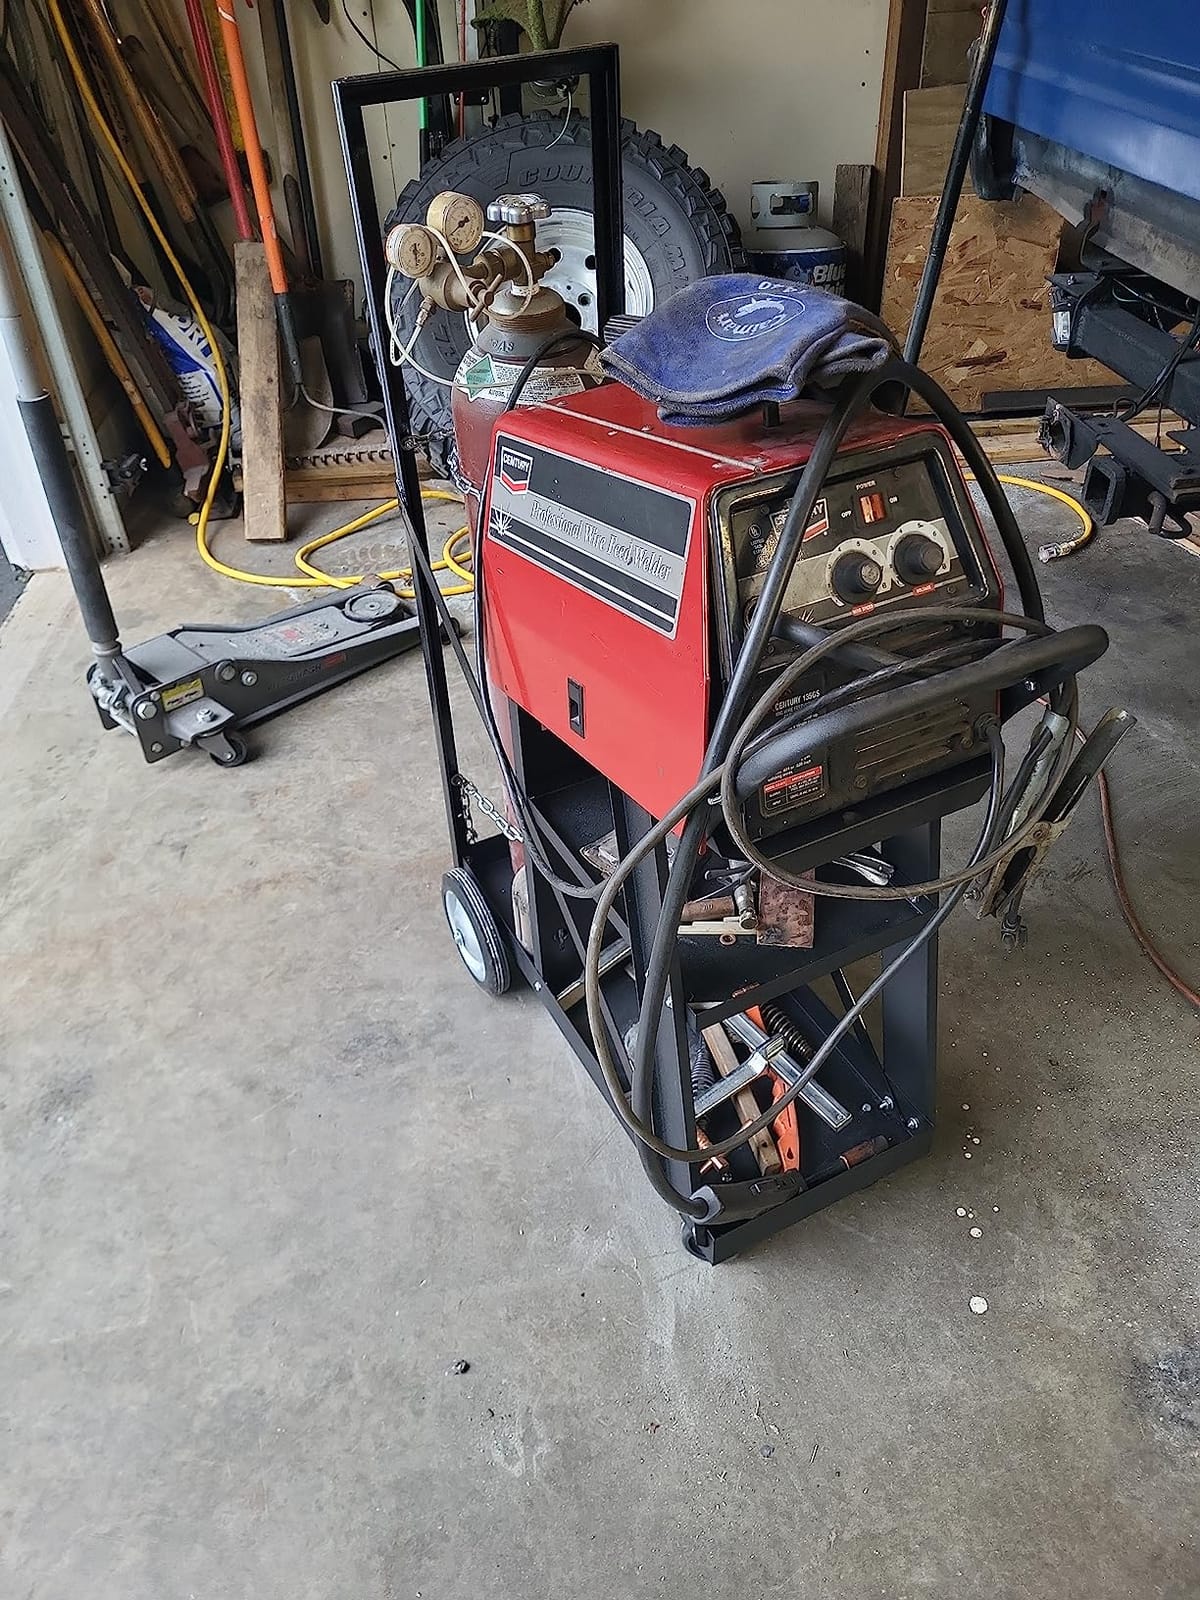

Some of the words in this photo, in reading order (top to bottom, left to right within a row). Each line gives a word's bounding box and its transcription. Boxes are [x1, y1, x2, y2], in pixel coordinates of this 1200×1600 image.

[502, 452, 531, 473] CENTURY
[856, 480, 876, 490] POWER
[888, 496, 898, 504] ON
[840, 510, 852, 519] OFF
[530, 498, 581, 540] Professional
[583, 521, 606, 551] Wire
[606, 533, 632, 565] Feed
[632, 543, 672, 582] Welder
[774, 695, 802, 712] CENTURY
